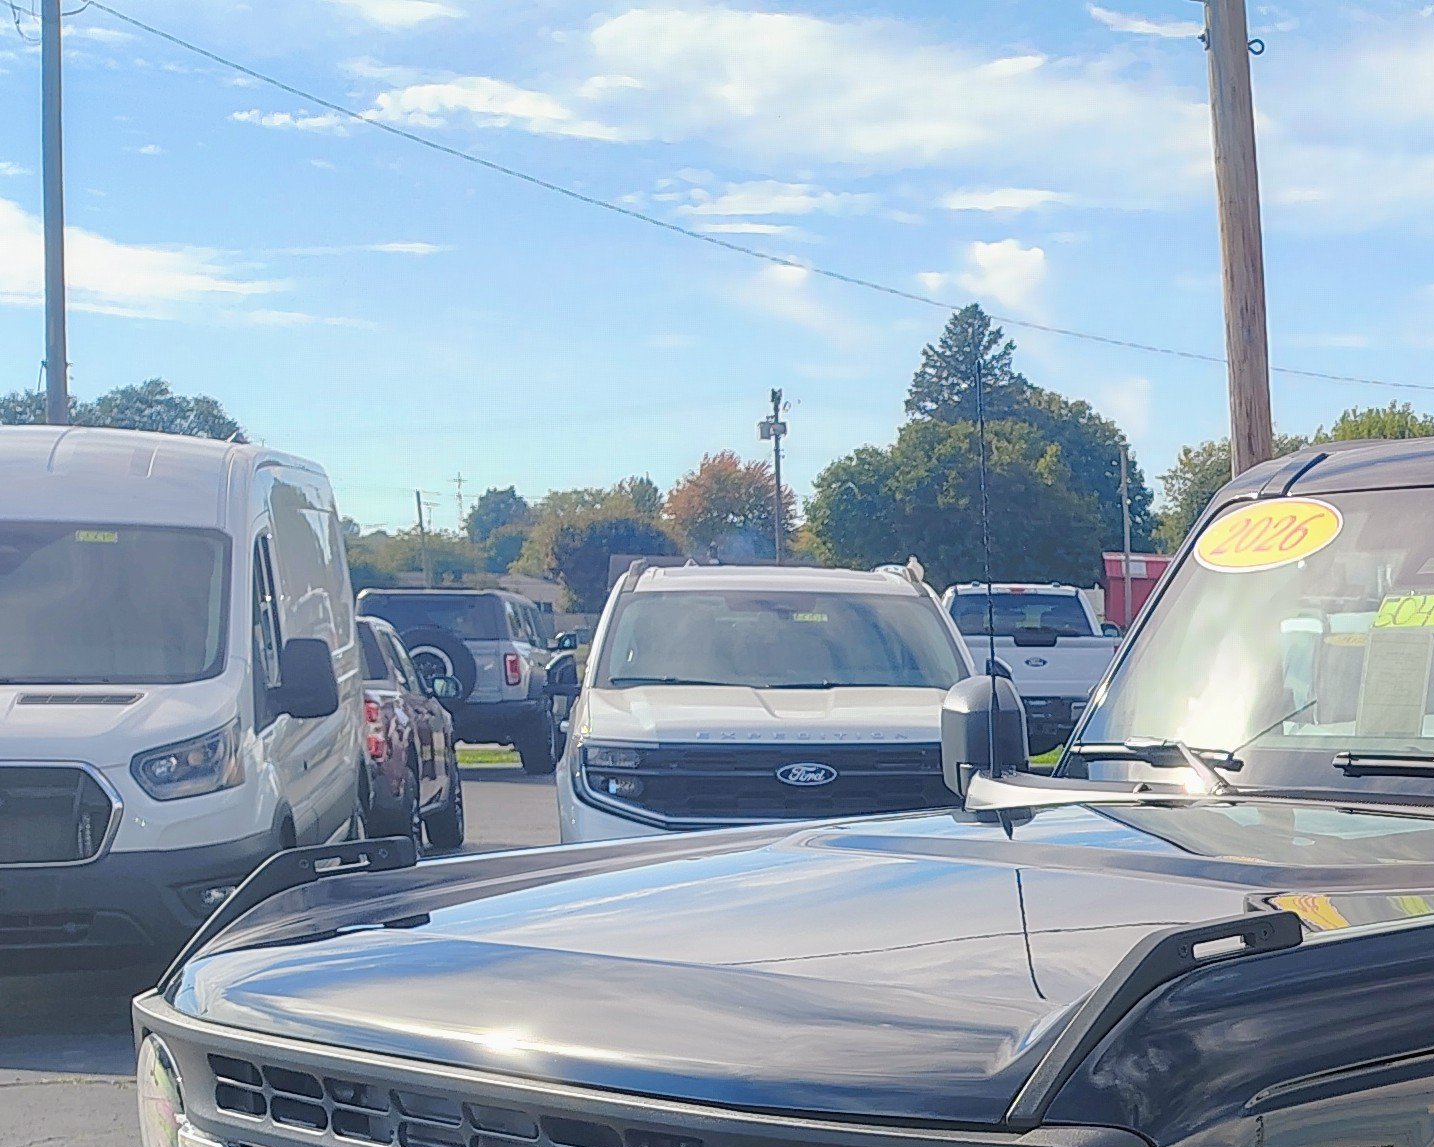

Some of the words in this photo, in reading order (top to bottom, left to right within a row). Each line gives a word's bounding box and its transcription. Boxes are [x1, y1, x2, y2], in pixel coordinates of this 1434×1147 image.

[1209, 512, 1325, 556] 2026
[695, 730, 908, 741] EXPEDITION
[788, 765, 826, 782] Ford
